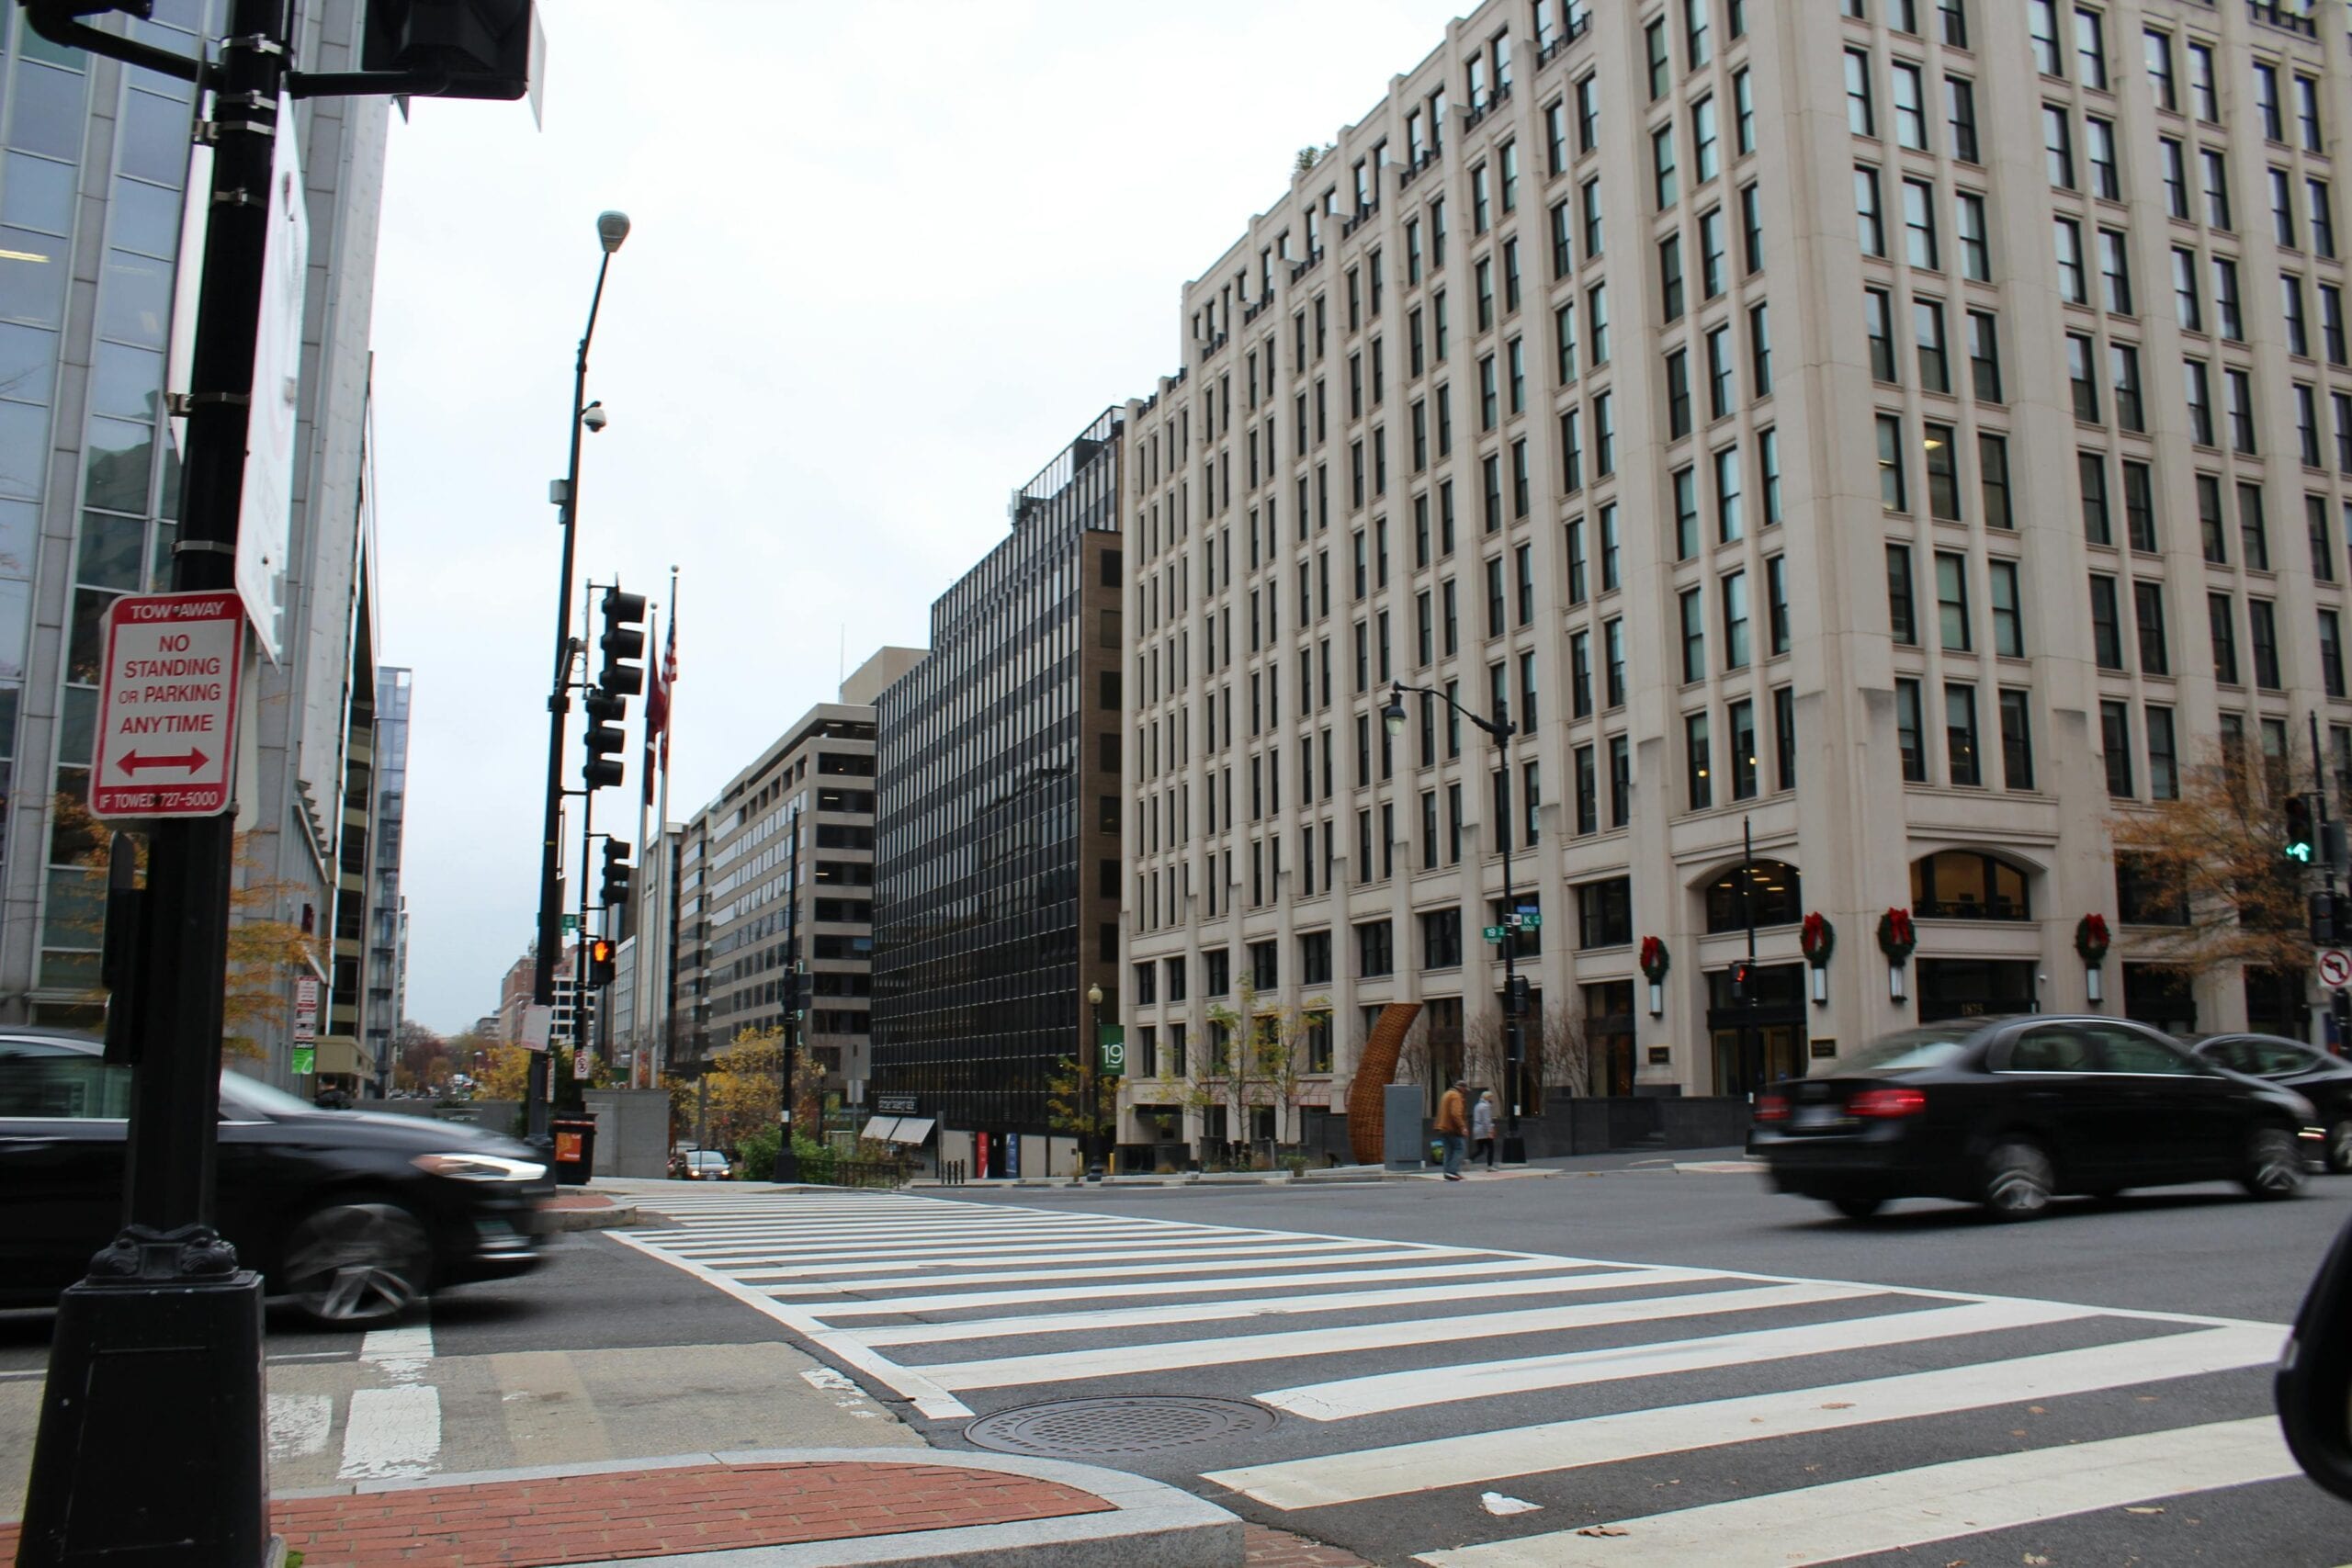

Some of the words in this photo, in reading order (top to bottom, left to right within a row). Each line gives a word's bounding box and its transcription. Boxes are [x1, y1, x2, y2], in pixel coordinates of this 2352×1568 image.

[159, 634, 190, 652] NO
[124, 657, 220, 679] STANDING
[118, 690, 139, 705] OR
[143, 682, 220, 703] PARKING
[119, 714, 213, 734] ANYTIME
[98, 794, 111, 808] IF
[159, 791, 218, 807] 727-5000
[1523, 915, 1532, 925] K
[1487, 928, 1496, 937] 19
[1102, 1043, 1124, 1064] 19
